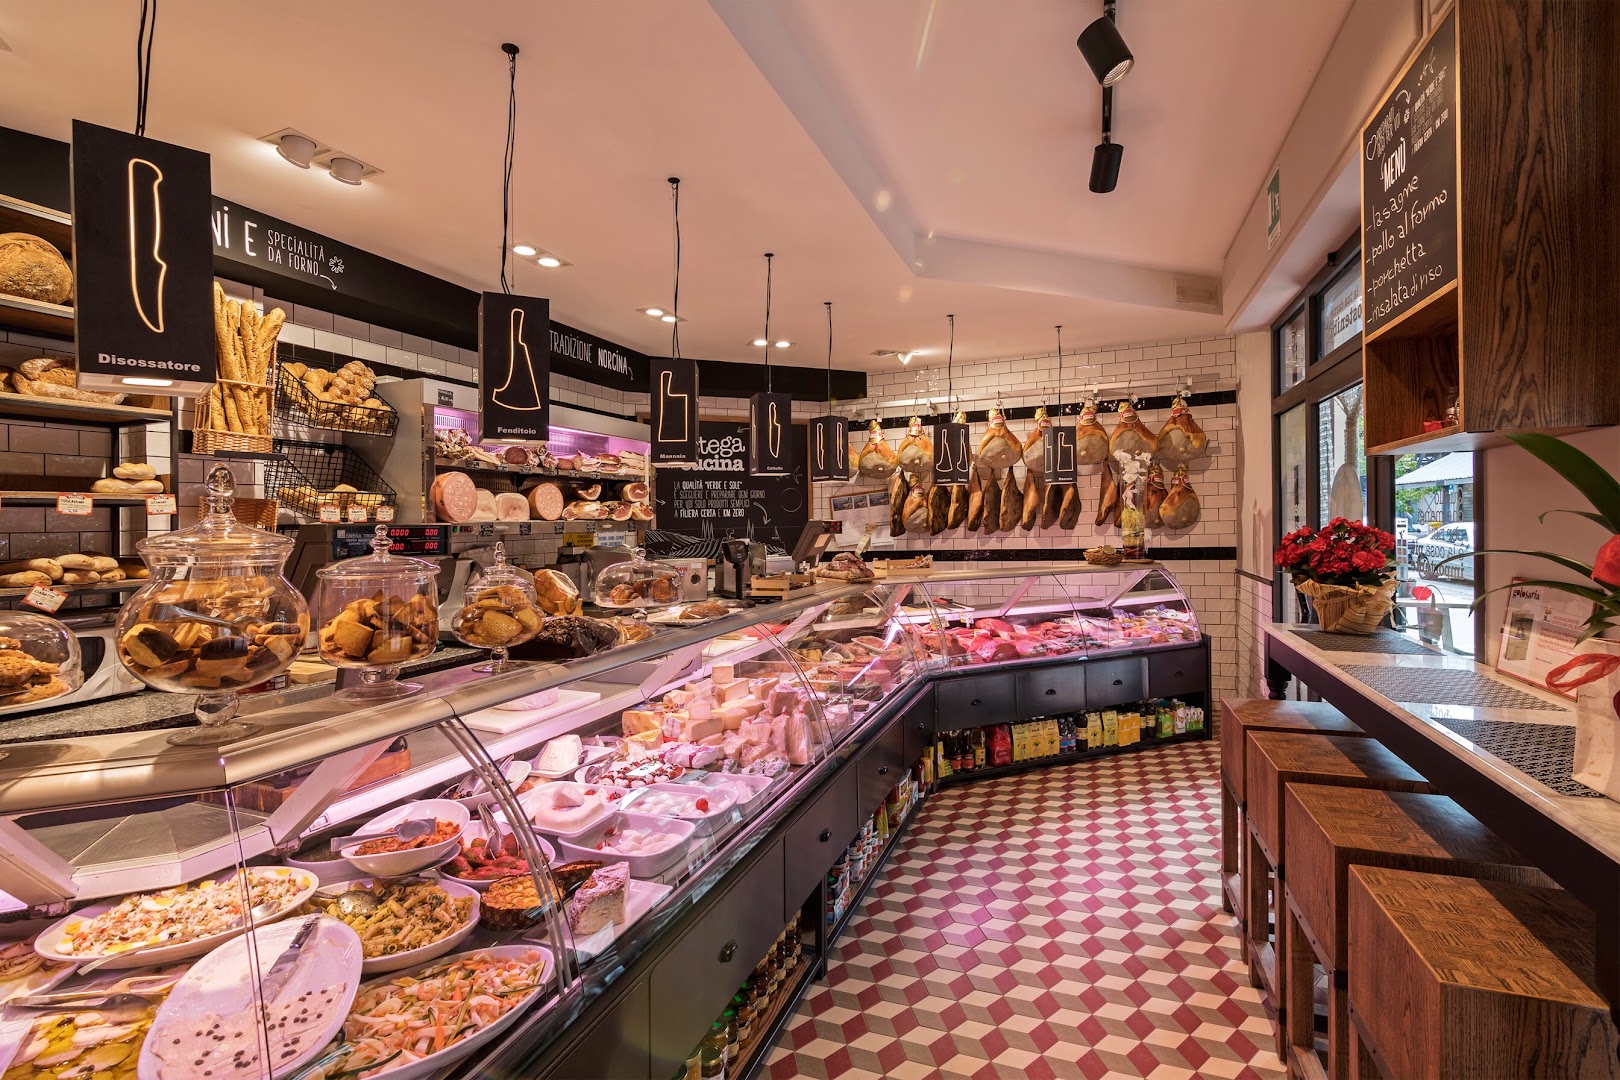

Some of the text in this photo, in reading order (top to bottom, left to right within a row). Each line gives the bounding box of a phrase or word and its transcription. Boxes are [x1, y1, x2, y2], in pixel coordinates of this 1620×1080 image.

[1384, 137, 1406, 192] MENÙ
[212, 206, 258, 256] NI E
[1397, 211, 1408, 239] al
[267, 230, 325, 262] SPECIALITÀ
[268, 246, 319, 276] DA FORNO
[1411, 274, 1418, 296] di
[1420, 264, 1442, 288] riso
[98, 352, 201, 373] Disossatore
[549, 330, 628, 375] TRADIZIONE NORCINA
[497, 426, 537, 435] Fenditoio
[698, 436, 746, 457] tega
[674, 480, 680, 489] LA
[682, 479, 703, 490] QUALITÀ
[705, 480, 722, 489] "VERDE
[724, 481, 727, 489] E
[711, 490, 736, 499] PREPARARE
[674, 500, 683, 508] PER
[695, 499, 706, 508] SOLO
[708, 499, 728, 508] PRODOTTI
[674, 509, 678, 518] A
[680, 508, 698, 518] FILIERA
[700, 509, 716, 517] CERTA
[723, 509, 730, 517] KM
[732, 508, 744, 517] ZERO
[1512, 587, 1540, 600] golosaria
